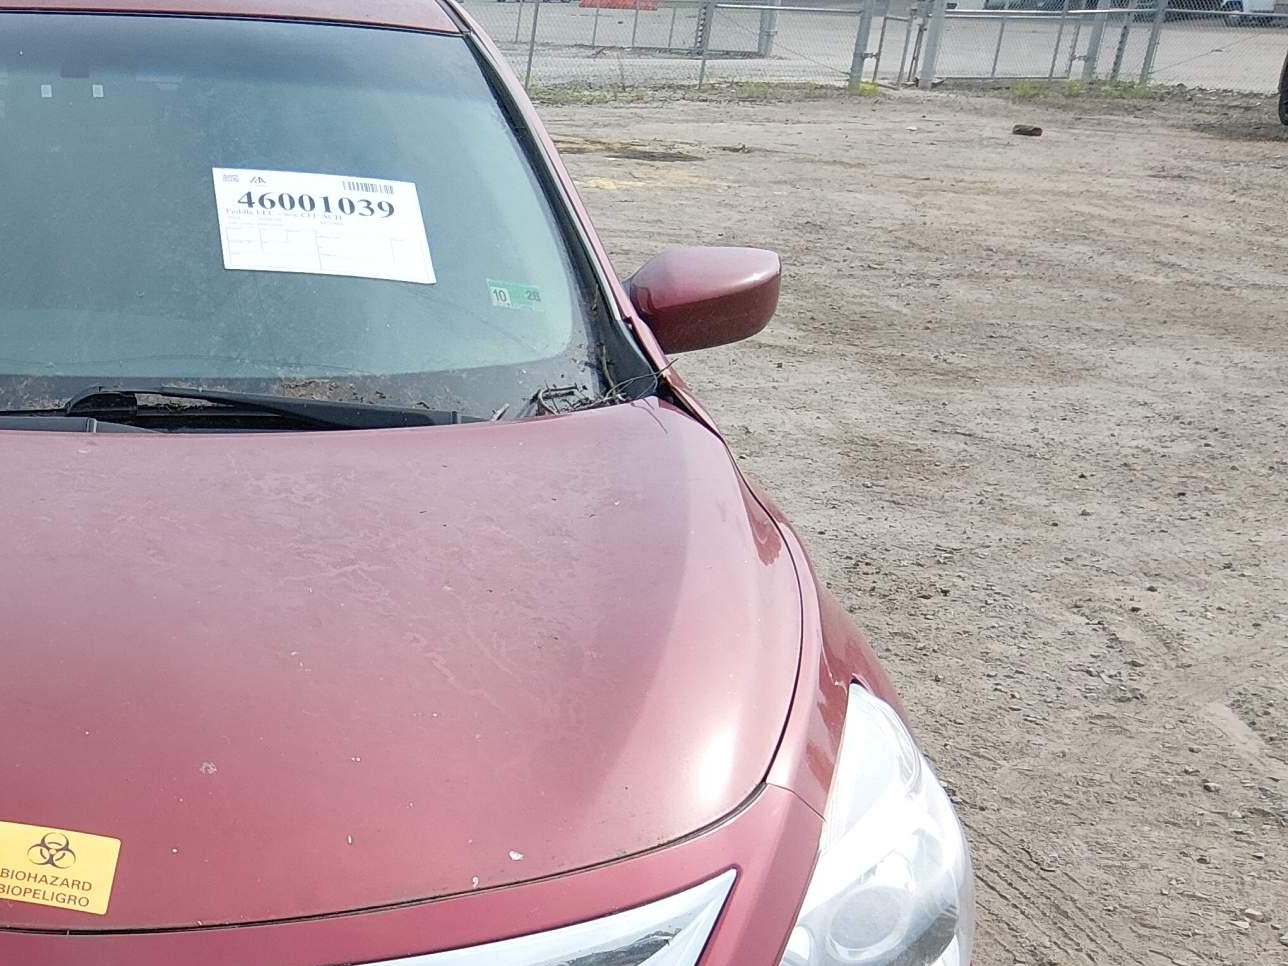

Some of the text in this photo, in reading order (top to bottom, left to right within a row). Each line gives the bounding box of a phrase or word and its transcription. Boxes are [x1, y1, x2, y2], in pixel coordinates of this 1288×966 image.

[237, 191, 395, 218] 46001039
[493, 288, 508, 303] 10
[0, 867, 92, 892] BIOHAZARD
